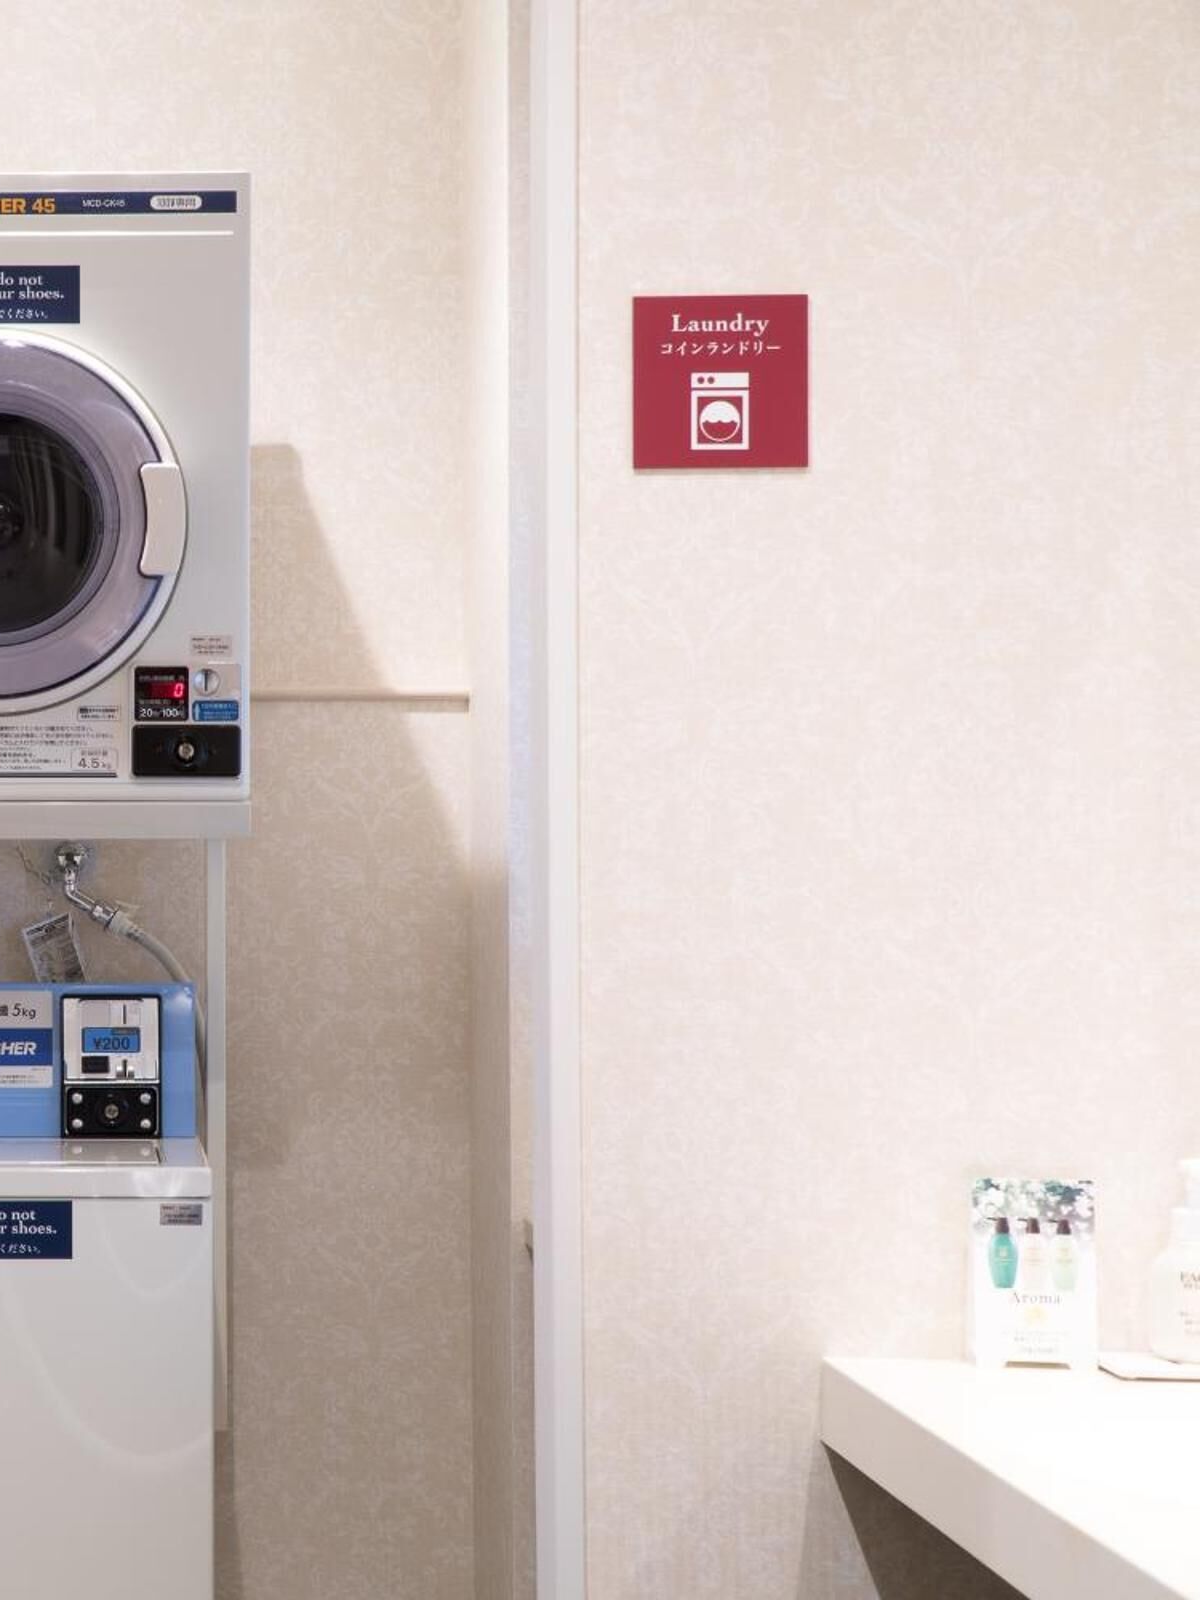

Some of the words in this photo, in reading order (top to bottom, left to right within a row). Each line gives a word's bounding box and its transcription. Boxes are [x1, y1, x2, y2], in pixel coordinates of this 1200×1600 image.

[32, 198, 56, 213] 45
[18, 274, 42, 286] not
[18, 286, 64, 300] shoes.
[671, 312, 770, 337] Laundry
[660, 340, 782, 357] コインランドリー
[173, 682, 185, 698] 0
[93, 1036, 131, 1051] ¥200
[11, 1208, 36, 1221] not
[11, 1220, 57, 1235] shoes.
[1011, 1292, 1063, 1305] Aroma
